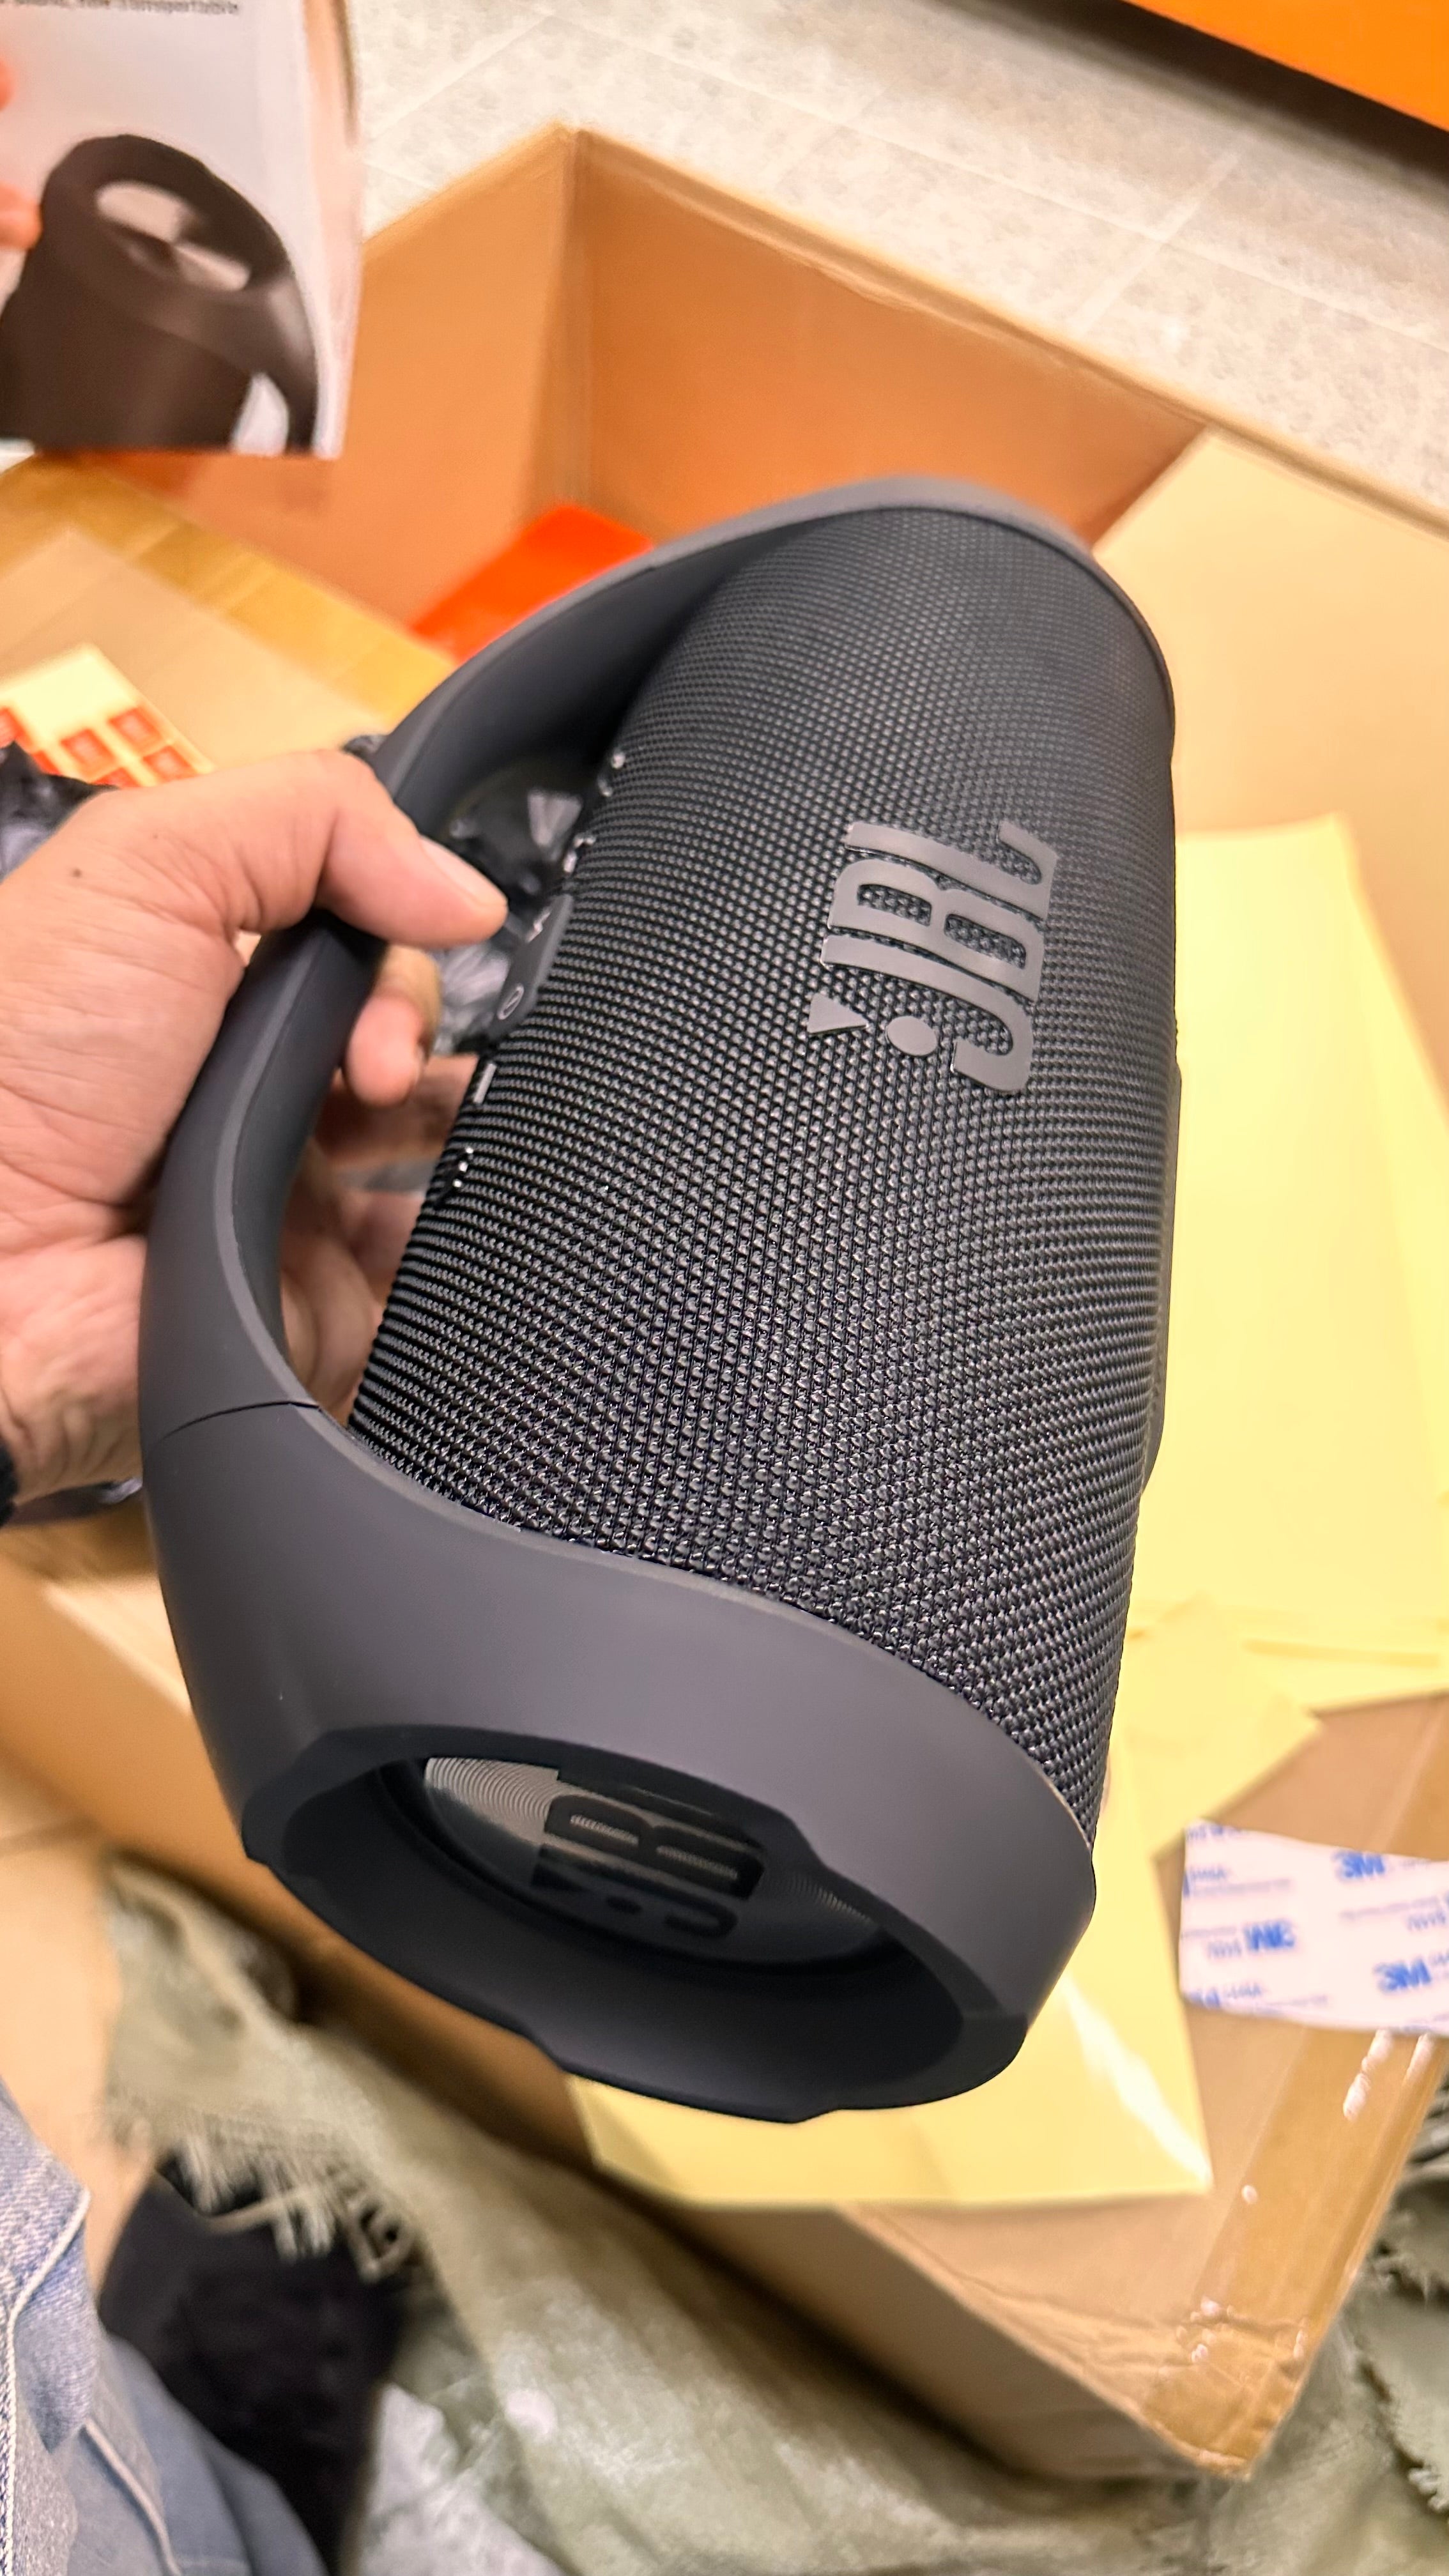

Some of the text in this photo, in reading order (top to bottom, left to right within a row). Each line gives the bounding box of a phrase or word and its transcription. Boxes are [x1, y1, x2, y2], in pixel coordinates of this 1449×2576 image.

[818, 822, 1058, 1092] JBL
[1333, 1850, 1385, 1879] 3M
[1374, 1958, 1432, 1993] 3M
